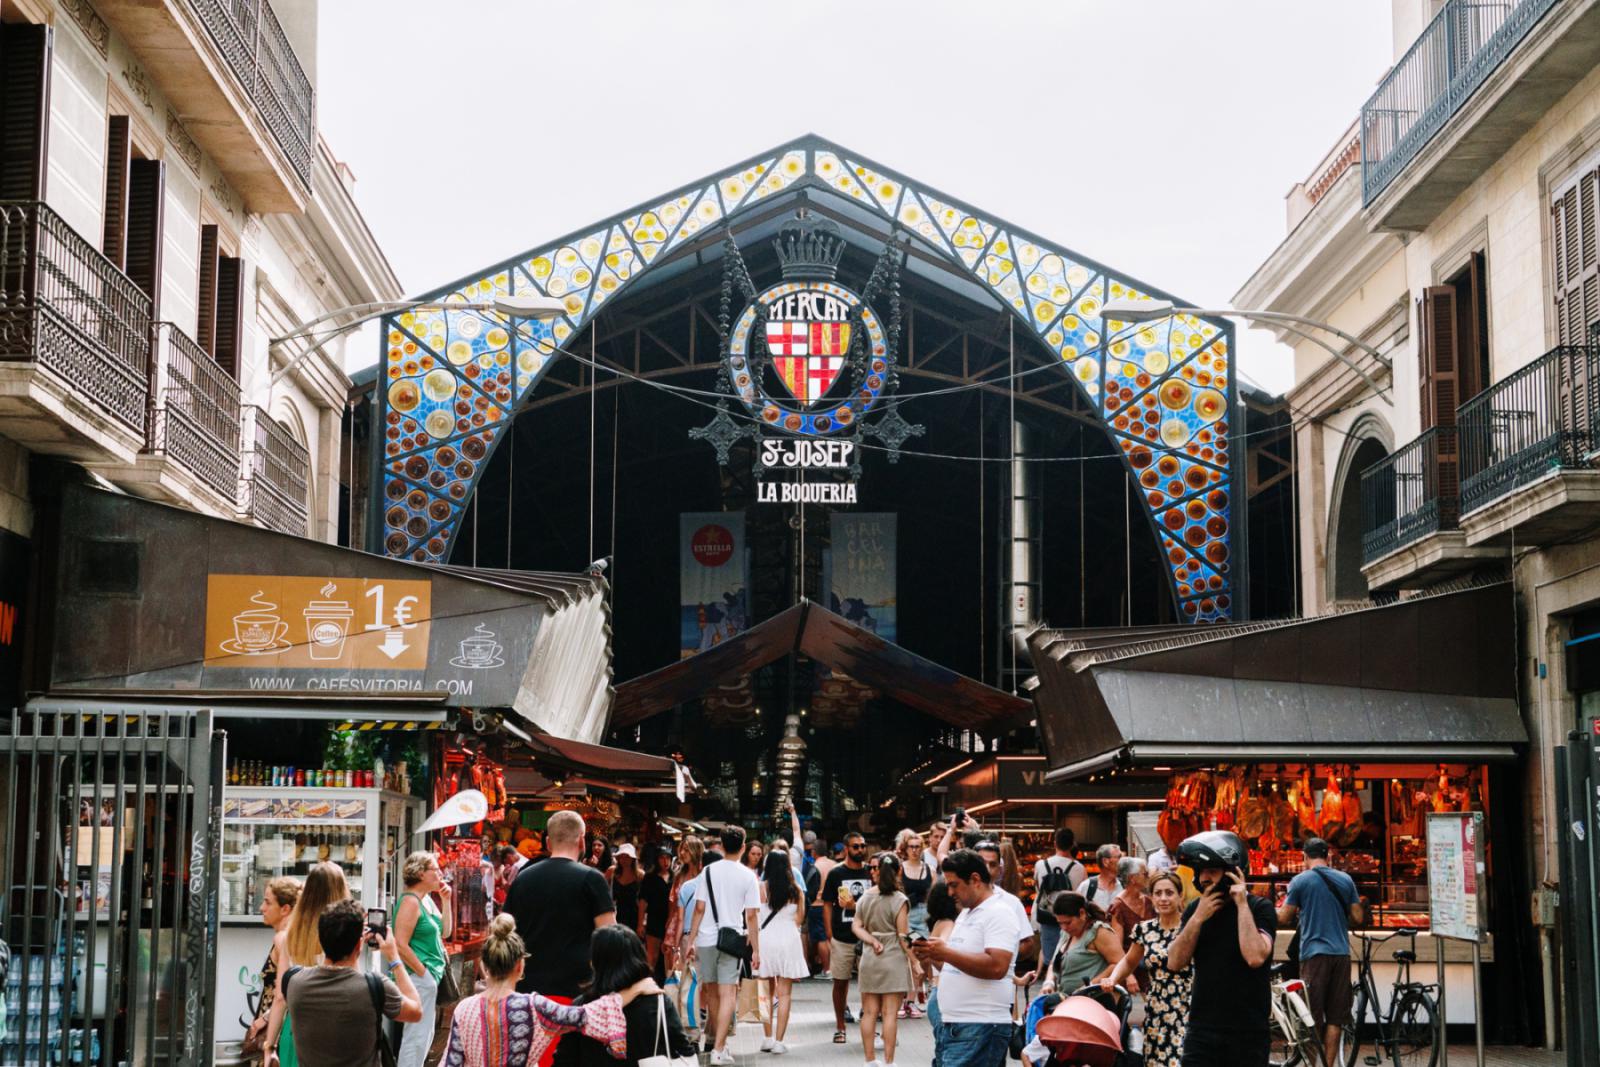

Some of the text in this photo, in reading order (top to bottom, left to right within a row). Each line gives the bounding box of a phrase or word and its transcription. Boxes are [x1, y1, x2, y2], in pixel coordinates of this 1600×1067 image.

[768, 291, 850, 321] MERCAT
[782, 439, 854, 468] JOSEP
[757, 482, 857, 504] LA BOQUERIA
[694, 544, 732, 552] ESTRELLA
